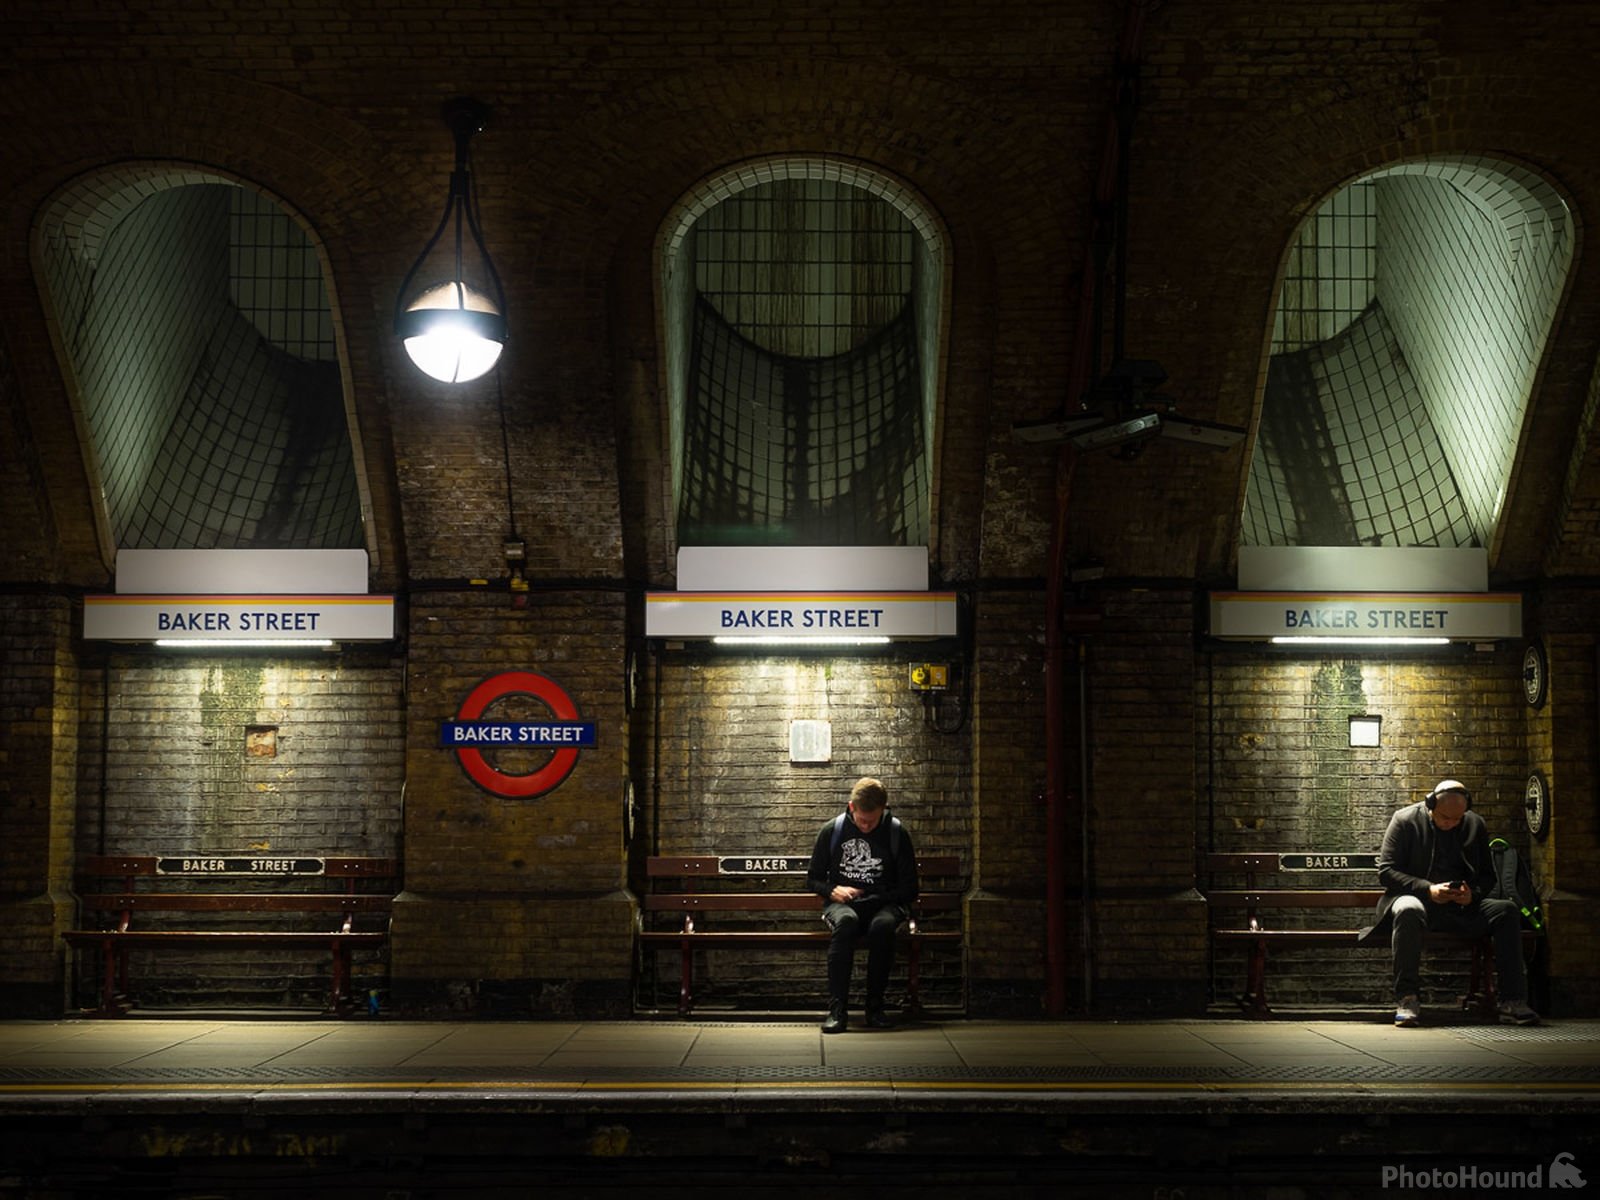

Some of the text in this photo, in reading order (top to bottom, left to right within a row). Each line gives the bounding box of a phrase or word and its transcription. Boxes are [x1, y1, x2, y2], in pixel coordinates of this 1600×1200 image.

[158, 612, 320, 631] BAKER STREET
[722, 609, 884, 628] BAKER STREET
[1285, 610, 1449, 628] BAKER STREET
[453, 726, 584, 742] BAKER STREET
[182, 859, 297, 872] BAKER STREET
[745, 859, 788, 871] BAKER
[1305, 856, 1349, 868] BAKER
